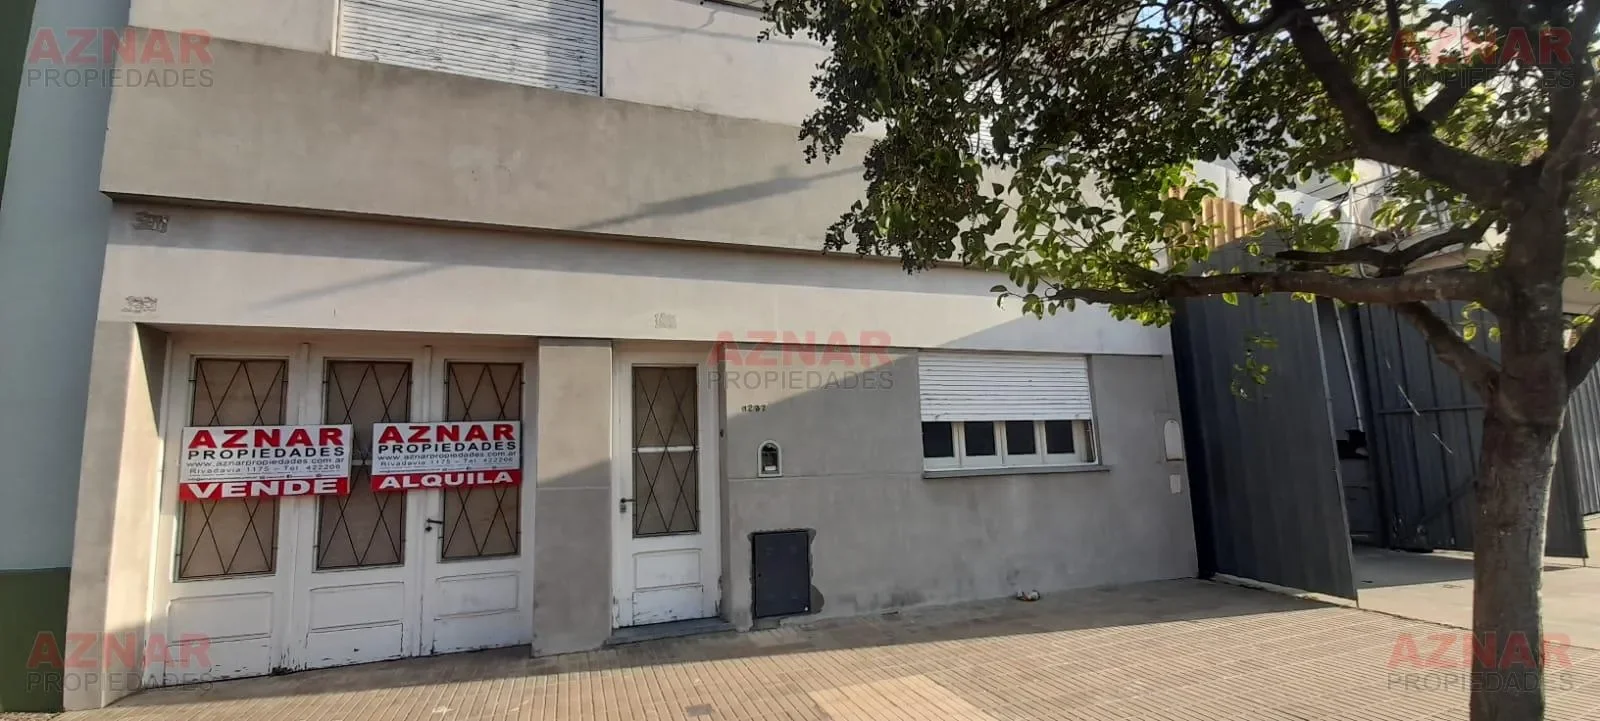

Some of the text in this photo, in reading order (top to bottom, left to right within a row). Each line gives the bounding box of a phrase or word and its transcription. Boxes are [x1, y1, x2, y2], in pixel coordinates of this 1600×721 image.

[188, 428, 344, 449] AZNAR
[378, 424, 516, 444] AZNAR
[187, 447, 345, 460] PROPIEDADES
[378, 441, 516, 454] PROPIEDADES
[246, 465, 269, 473] 1175
[187, 478, 338, 499] VENDE
[378, 471, 514, 489] ALQUILA
